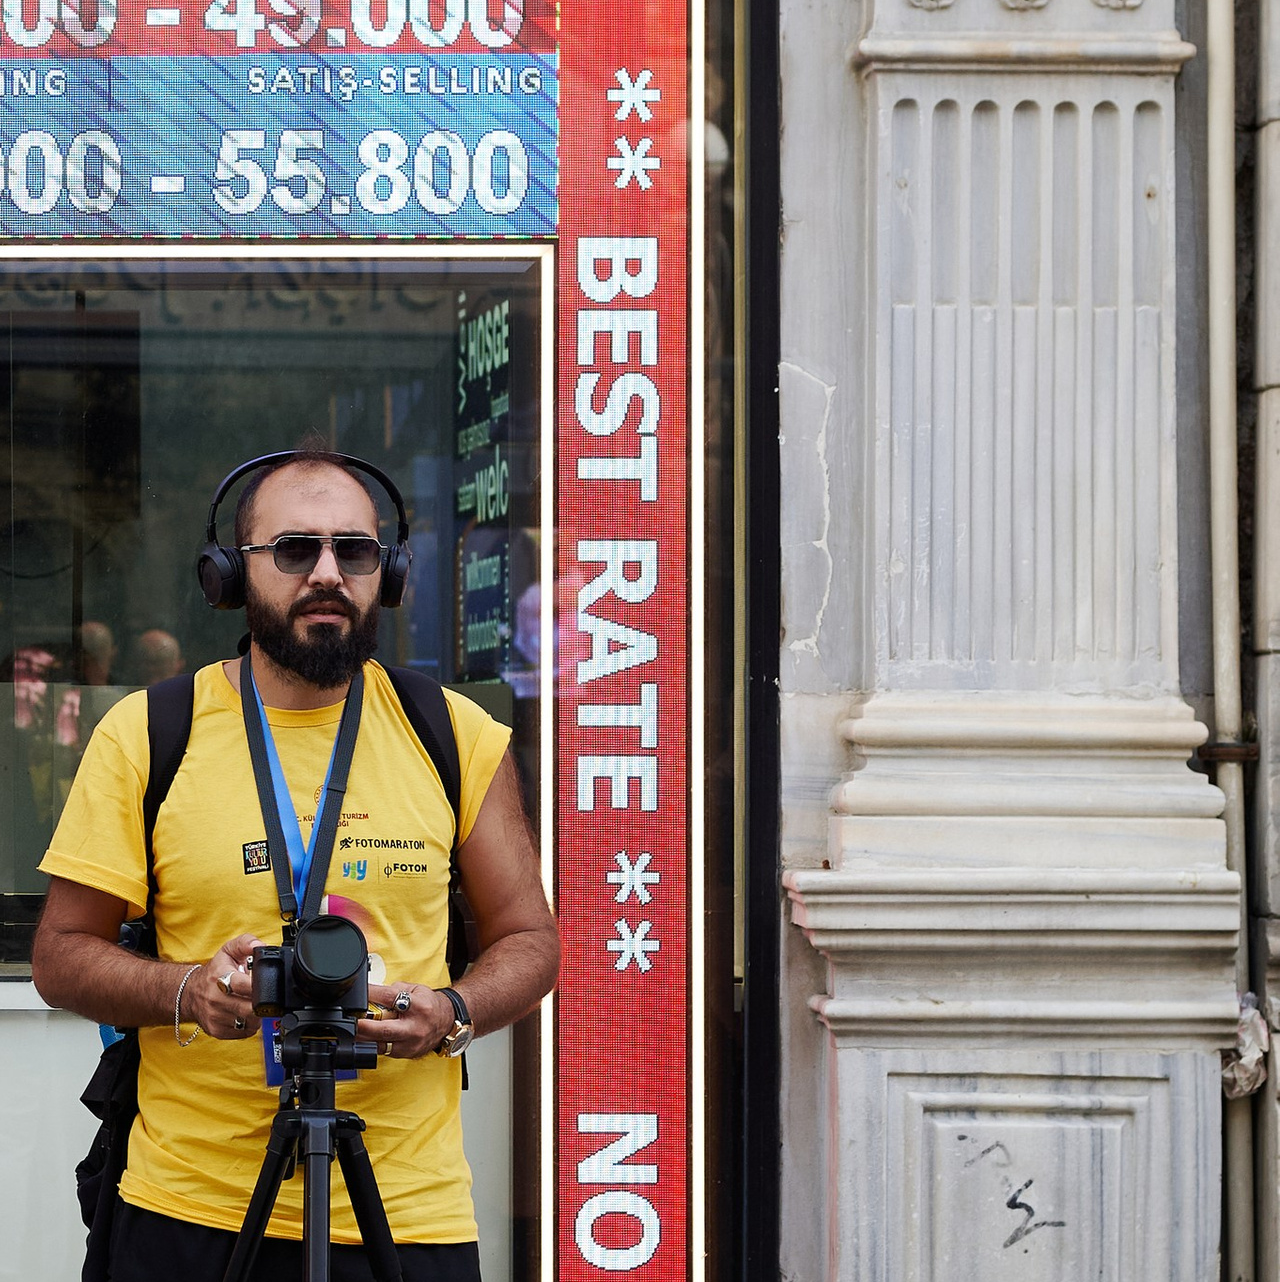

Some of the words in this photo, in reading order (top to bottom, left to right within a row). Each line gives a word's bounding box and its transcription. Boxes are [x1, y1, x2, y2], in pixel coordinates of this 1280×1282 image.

[212, 128, 529, 215] 55.800
[575, 235, 661, 503] BEST
[576, 539, 660, 813] RATE
[355, 838, 425, 850] FOTOMARATON
[393, 863, 427, 873] FOTON
[574, 1112, 662, 1272] NO
